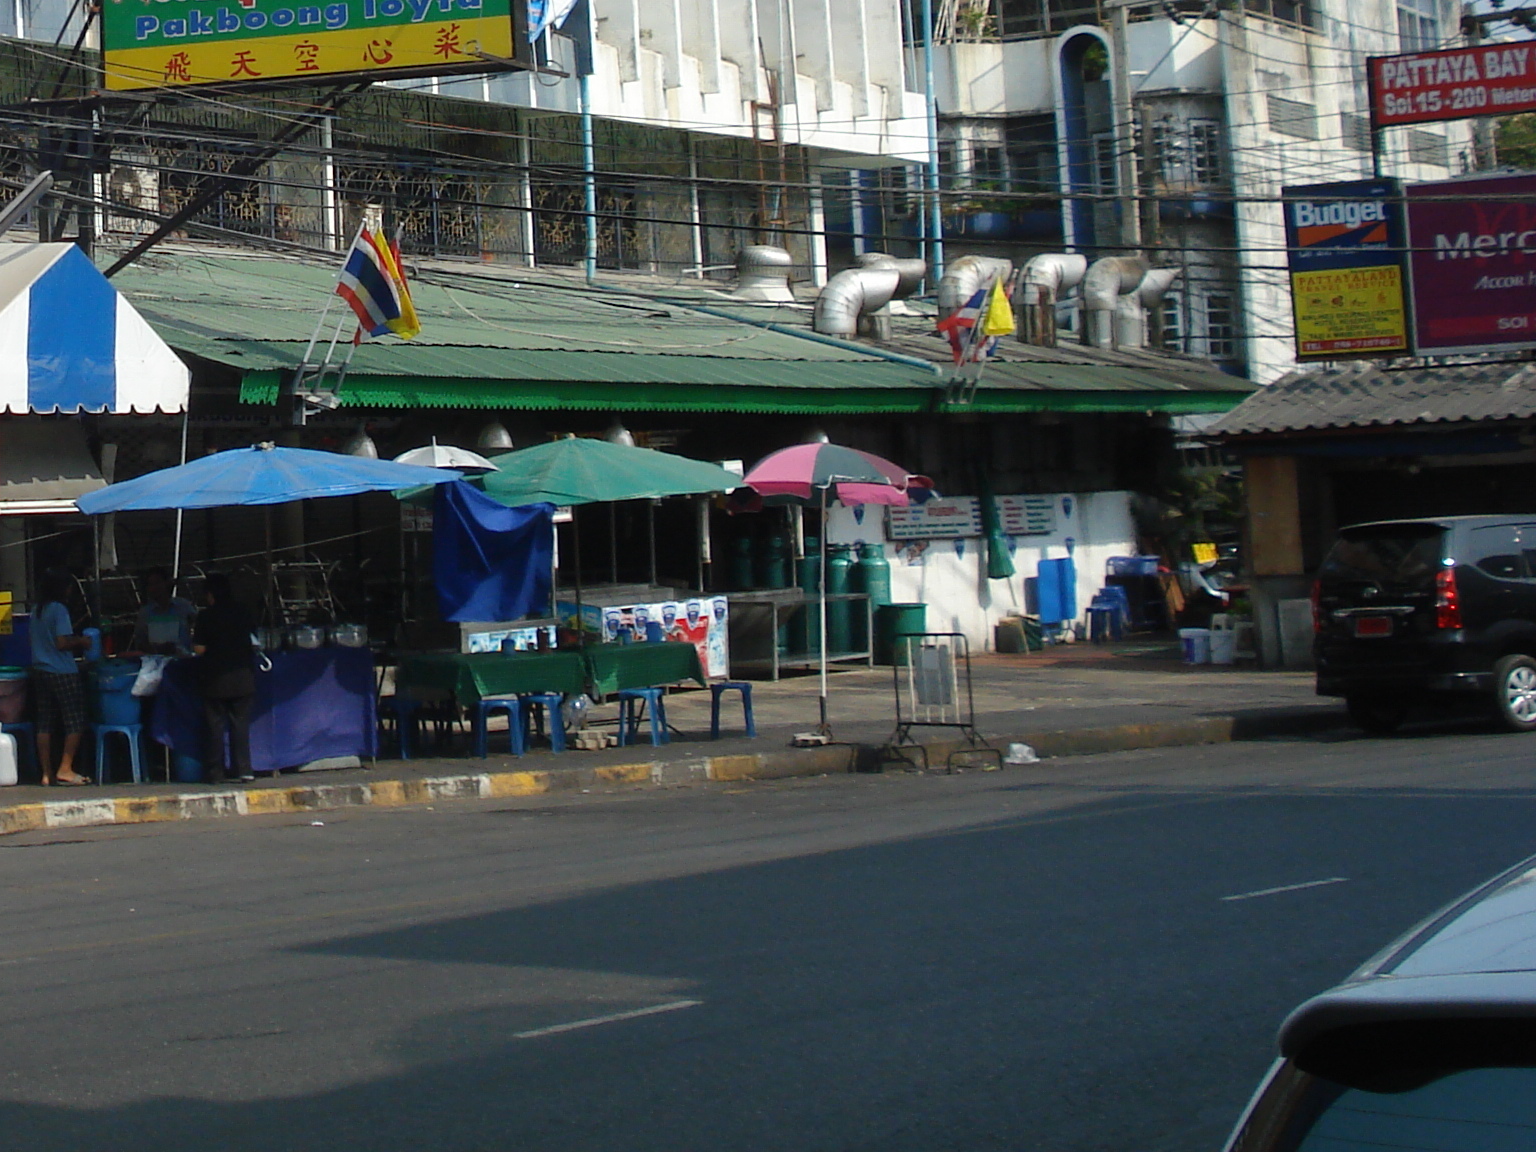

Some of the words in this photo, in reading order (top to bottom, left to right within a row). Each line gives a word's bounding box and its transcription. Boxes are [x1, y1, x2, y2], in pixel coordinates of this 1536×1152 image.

[1382, 54, 1480, 90] PATTAYA
[1484, 47, 1530, 79] BAY
[1295, 200, 1386, 229] Budget
[1298, 269, 1397, 286] PATTAYALAND
[1498, 316, 1528, 329] SOI
